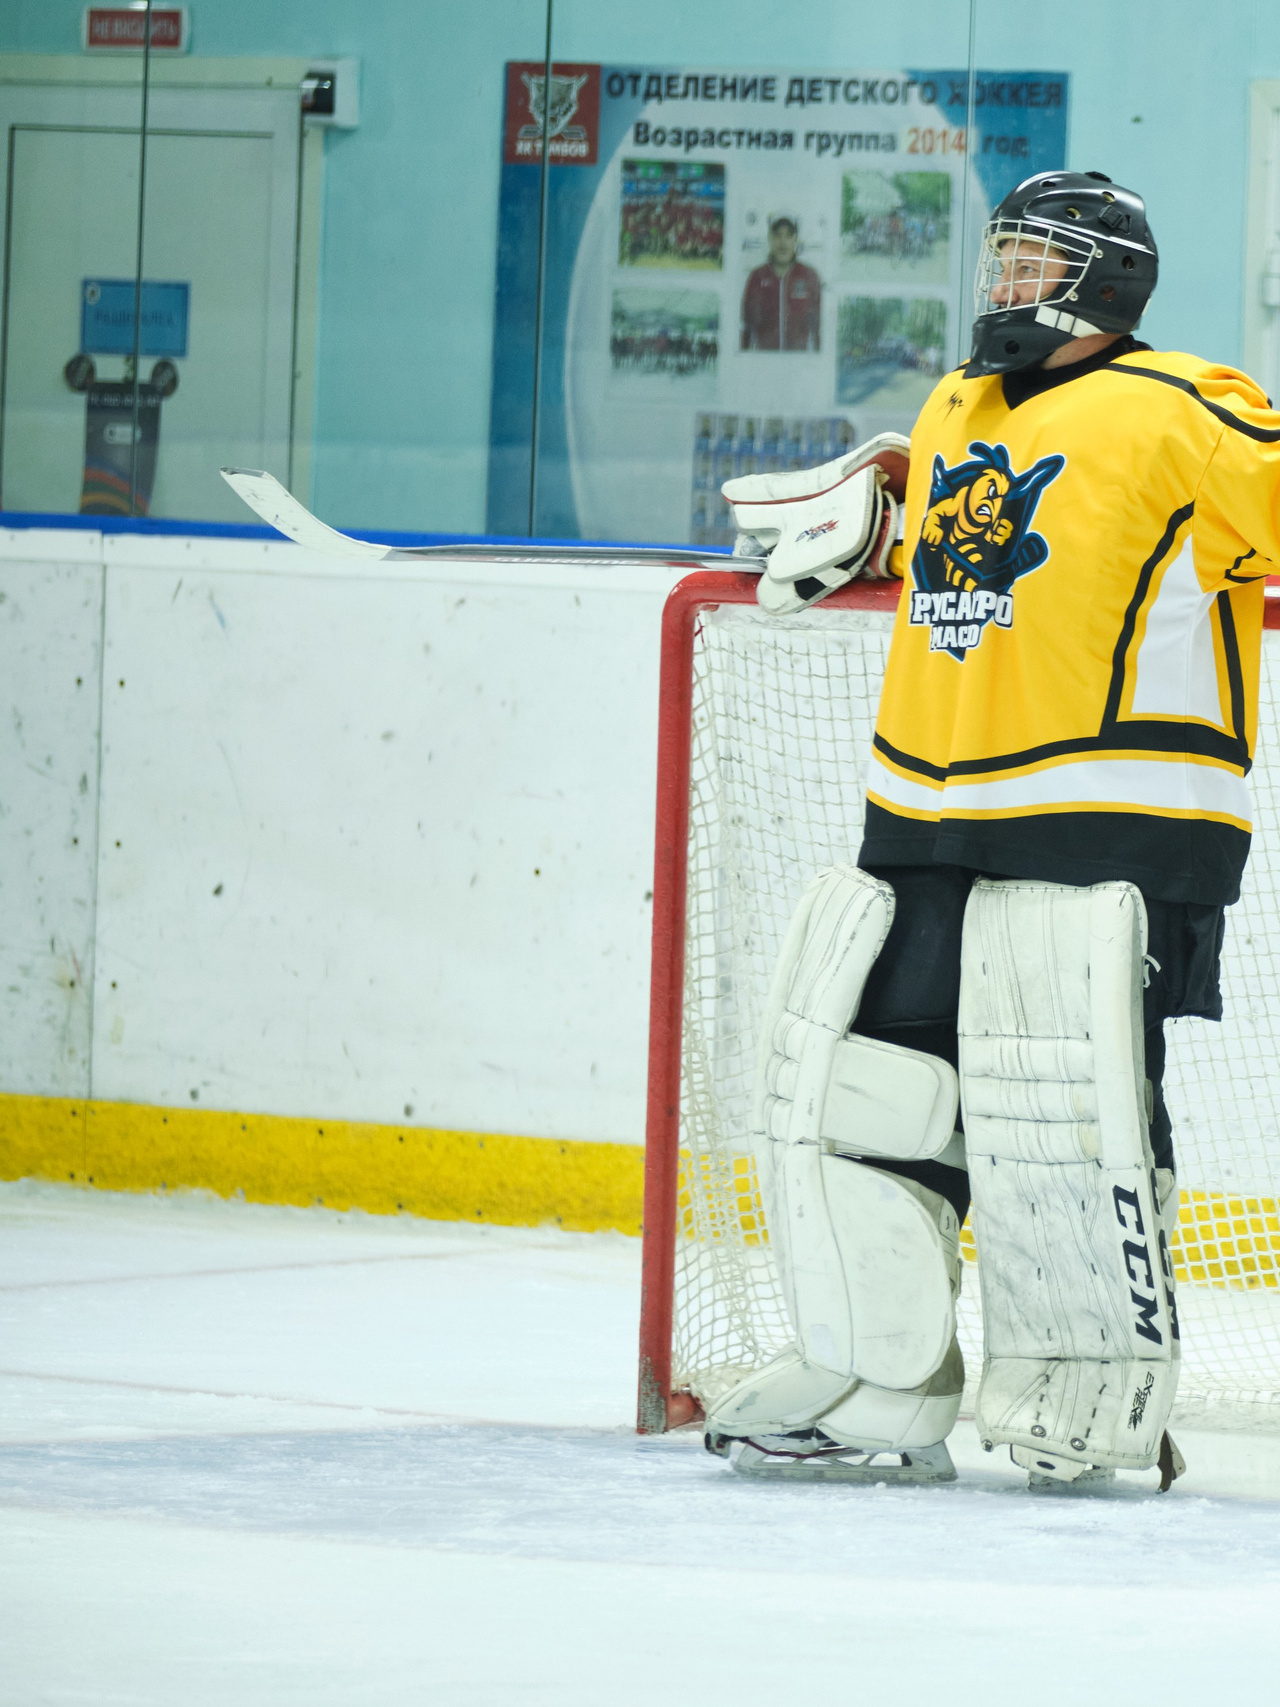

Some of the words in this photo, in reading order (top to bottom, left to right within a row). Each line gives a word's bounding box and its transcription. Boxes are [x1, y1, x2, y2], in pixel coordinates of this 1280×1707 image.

[606, 72, 777, 105] ОТДЕЛЕНИЕ
[784, 76, 938, 108] ДЕТСКОГО
[947, 79, 1063, 108] ХОККЕЯ
[535, 140, 589, 157] ТМБОВ
[633, 121, 795, 154] Возрастная
[803, 129, 896, 158] группа
[908, 126, 967, 154] 2014
[1112, 1184, 1163, 1346] CCM
